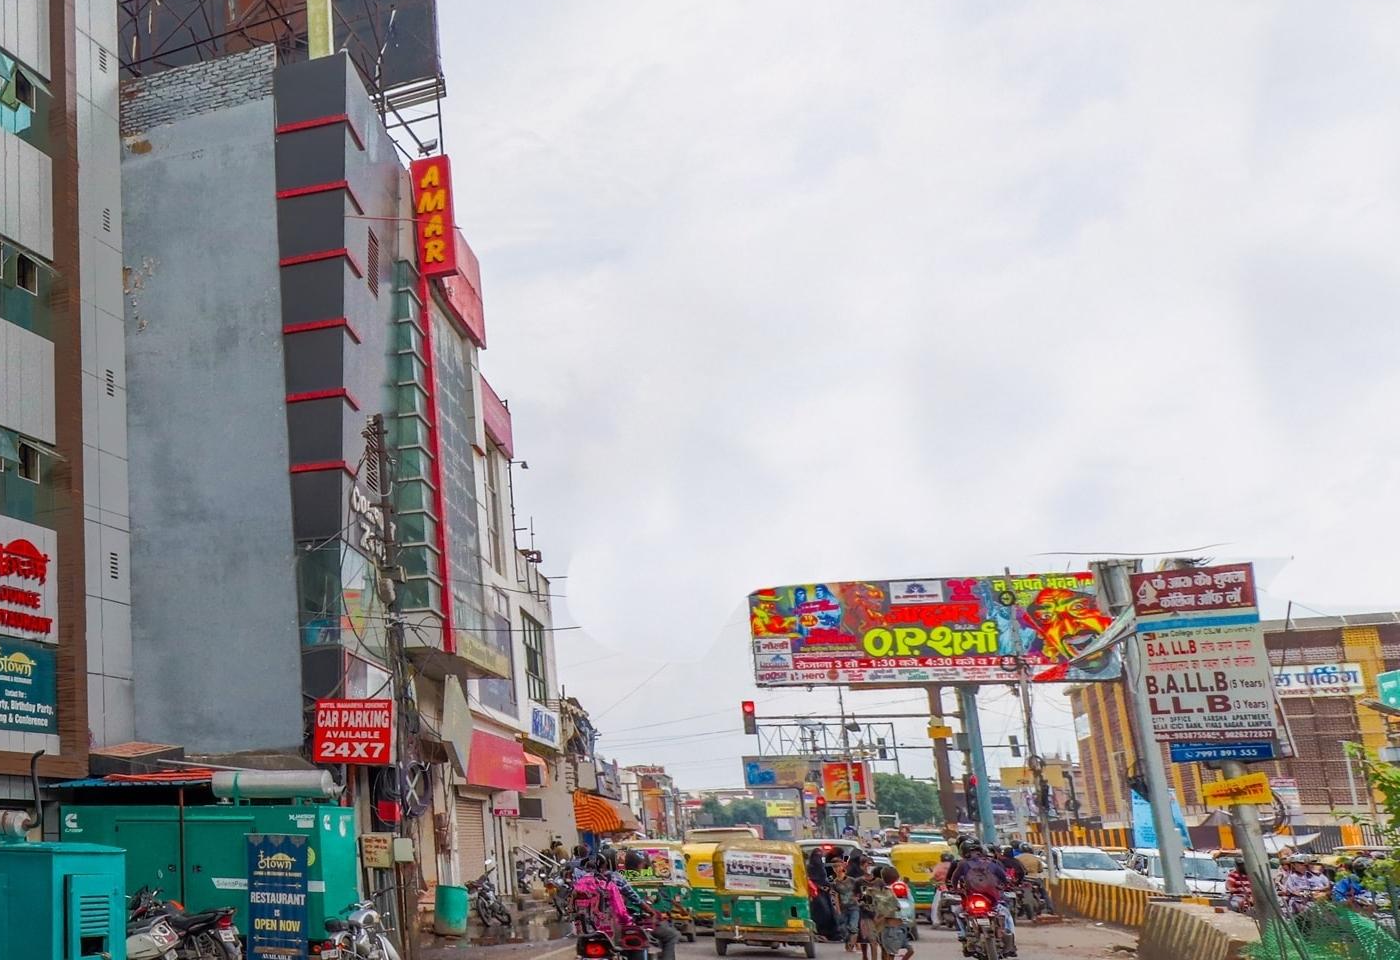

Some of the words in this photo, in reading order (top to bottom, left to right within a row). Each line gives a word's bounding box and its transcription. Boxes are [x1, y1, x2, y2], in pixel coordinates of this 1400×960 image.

[417, 165, 446, 263] AMAR
[1171, 640, 1197, 655] LL.B
[835, 660, 842, 668] 3
[871, 660, 895, 668] 1:30
[926, 657, 955, 666] 4:30
[1145, 671, 1229, 695] B.A.LL.B
[1294, 666, 1358, 685] पार्किंग
[1149, 694, 1232, 716] LL.B
[317, 710, 339, 728] CAR
[341, 710, 390, 728] PARKING
[325, 730, 380, 739] AVAILABLE
[320, 741, 385, 758] 24X7
[250, 891, 306, 906] RESTAURANT
[274, 909, 280, 917] IS
[254, 918, 277, 931] OPEN
[280, 920, 300, 933] NOW
